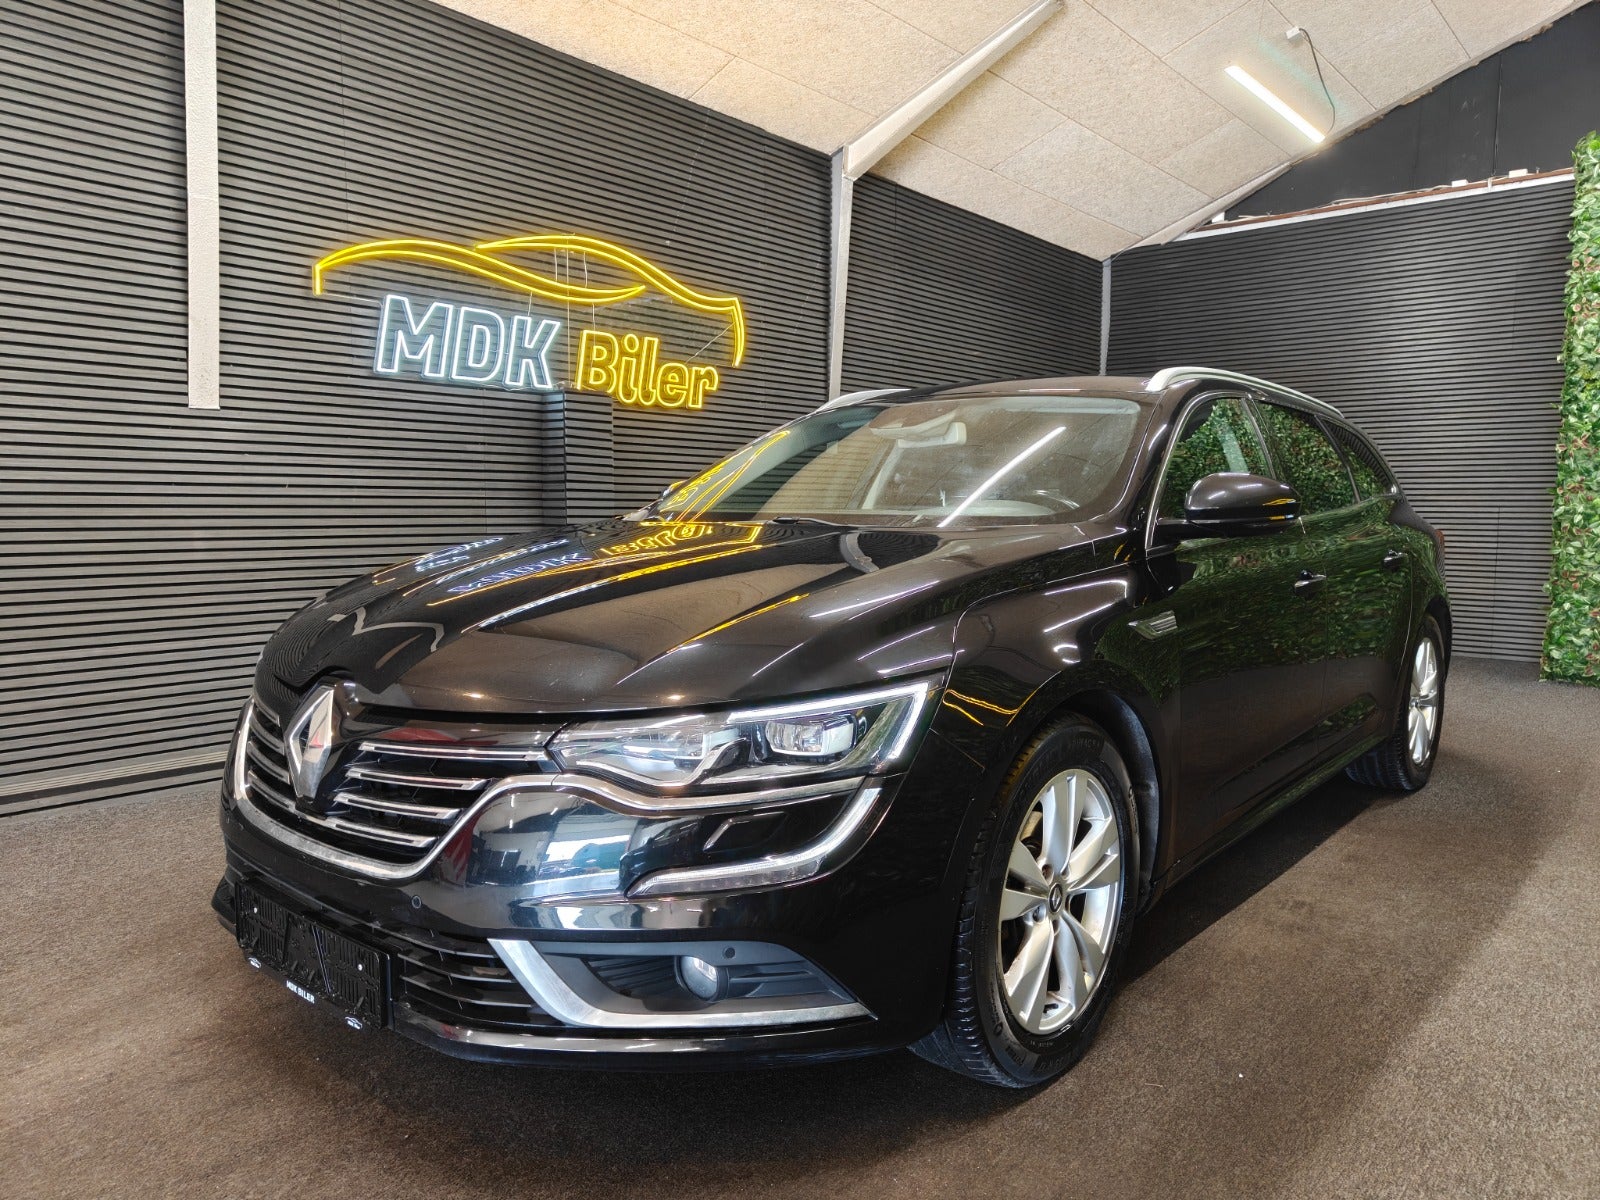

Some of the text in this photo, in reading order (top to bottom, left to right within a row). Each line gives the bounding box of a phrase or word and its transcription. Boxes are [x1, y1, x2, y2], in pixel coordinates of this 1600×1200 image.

[375, 294, 719, 408] MDK Biler
[297, 987, 315, 1004] BILER
